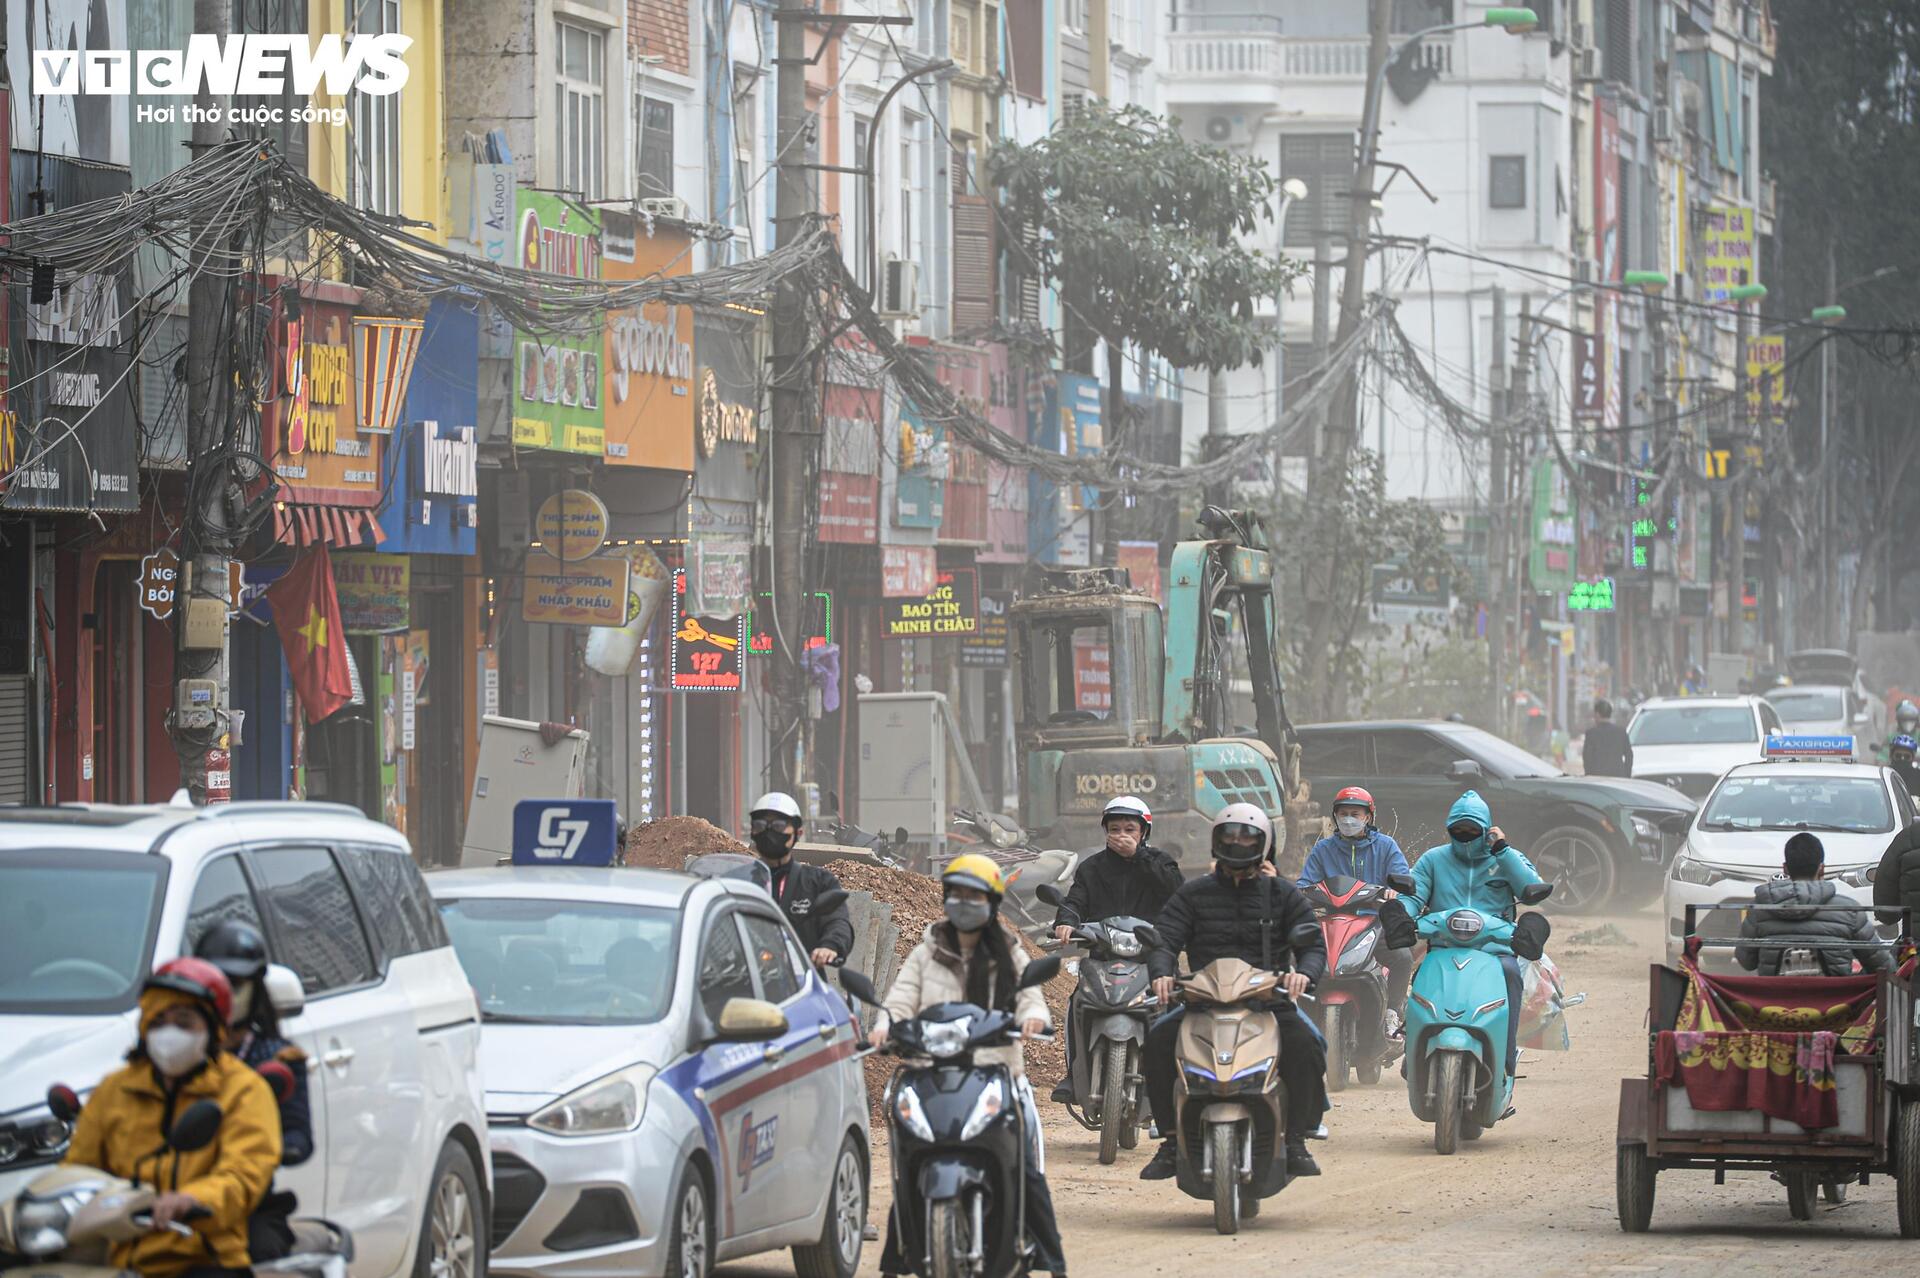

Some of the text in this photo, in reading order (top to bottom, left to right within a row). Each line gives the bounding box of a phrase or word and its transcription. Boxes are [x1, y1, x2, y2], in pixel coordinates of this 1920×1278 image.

[151, 567, 177, 581] NG
[690, 652, 723, 671] 127
[1076, 764, 1157, 794] KOBELCO
[533, 807, 590, 860] G7
